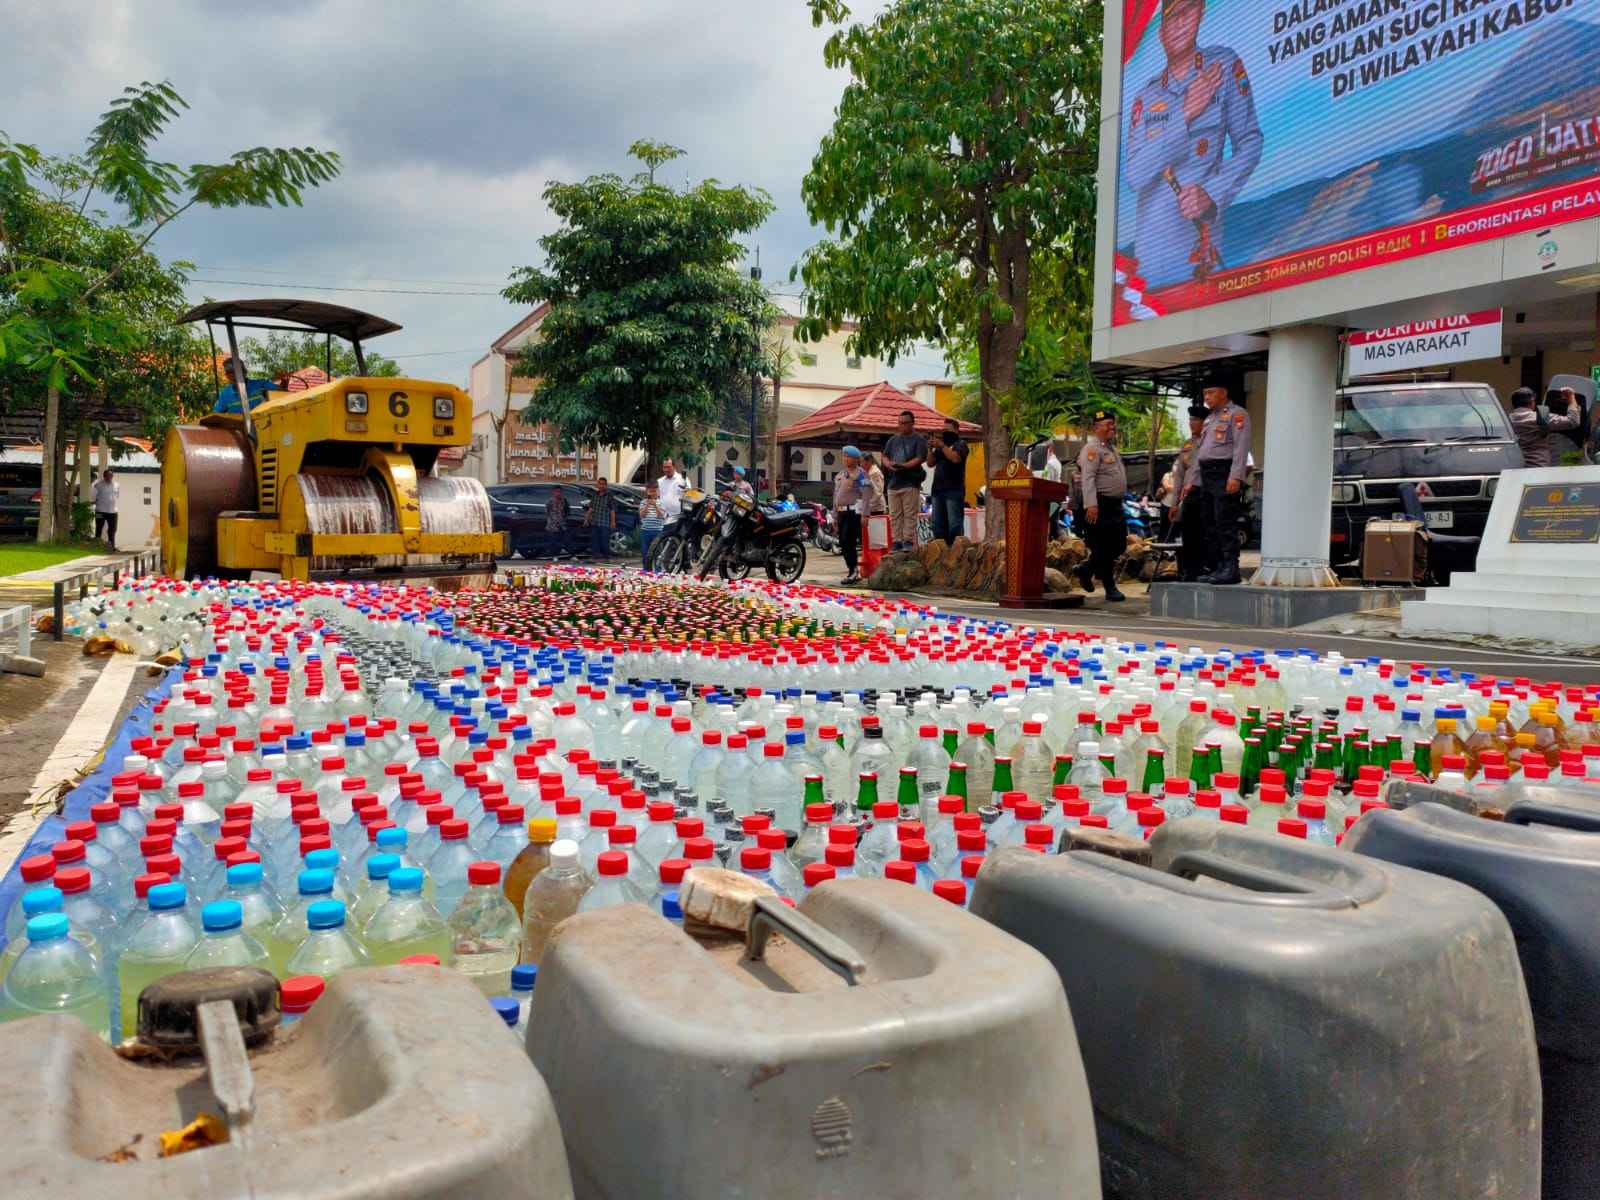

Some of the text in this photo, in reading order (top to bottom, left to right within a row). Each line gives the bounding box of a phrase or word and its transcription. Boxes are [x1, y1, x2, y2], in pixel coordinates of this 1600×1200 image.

[1274, 0, 1347, 34] DALA
[1312, 0, 1447, 76] BULAN SUCI
[1269, 22, 1326, 64] YANG
[1333, 69, 1354, 97] DI
[1360, 19, 1476, 86] WILAYAH
[1483, 0, 1573, 39] KABU
[1218, 271, 1262, 295] POLRES
[1264, 255, 1325, 282] JOMBANG
[1329, 243, 1373, 267] POLISI
[1376, 233, 1412, 256] BAIK
[1435, 203, 1547, 240] BERORIENTASI
[1364, 331, 1471, 361] MASYARAKAT
[388, 391, 410, 418] 6
